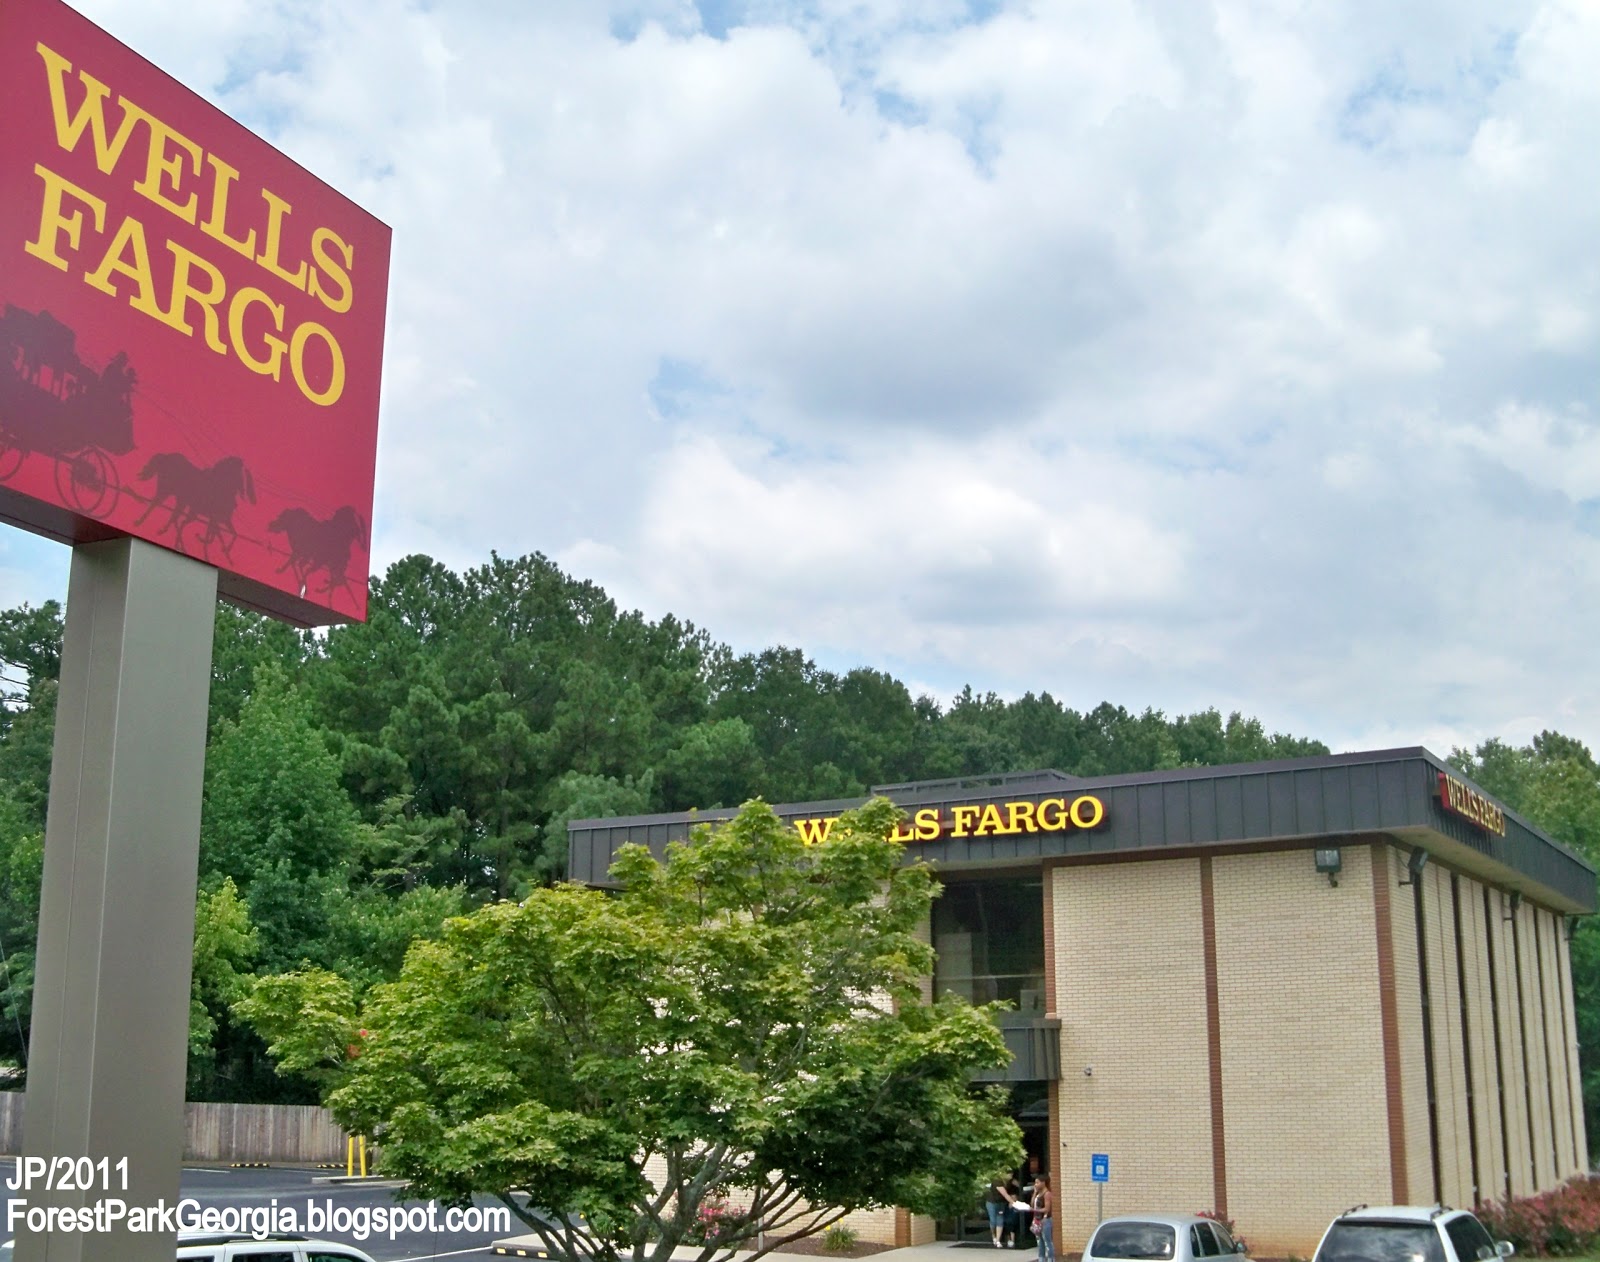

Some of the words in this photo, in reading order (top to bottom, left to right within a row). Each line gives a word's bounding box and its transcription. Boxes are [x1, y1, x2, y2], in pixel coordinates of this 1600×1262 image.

[24, 162, 346, 407] FARGO
[36, 41, 354, 314] WELLS
[950, 795, 1104, 838] FARGO
